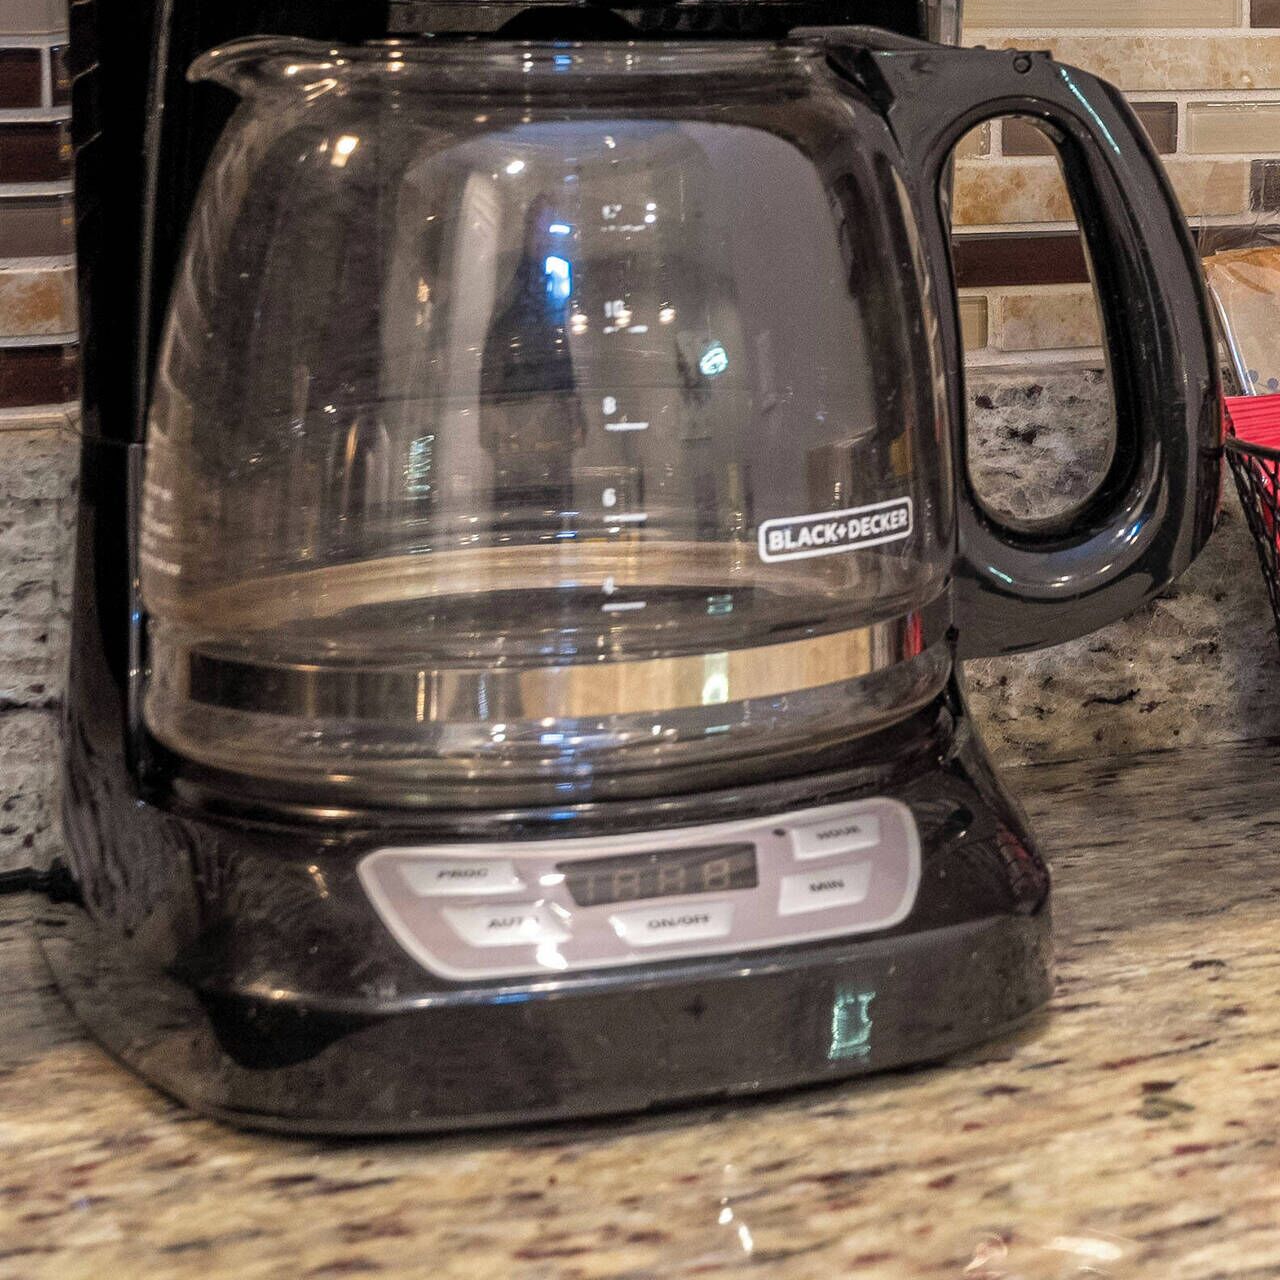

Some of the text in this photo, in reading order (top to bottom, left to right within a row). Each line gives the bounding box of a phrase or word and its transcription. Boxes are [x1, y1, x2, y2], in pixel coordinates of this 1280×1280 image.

[602, 396, 617, 415] 8
[602, 488, 617, 507] 6
[768, 508, 908, 552] BLACK+DECKER
[487, 917, 540, 929] AUT
